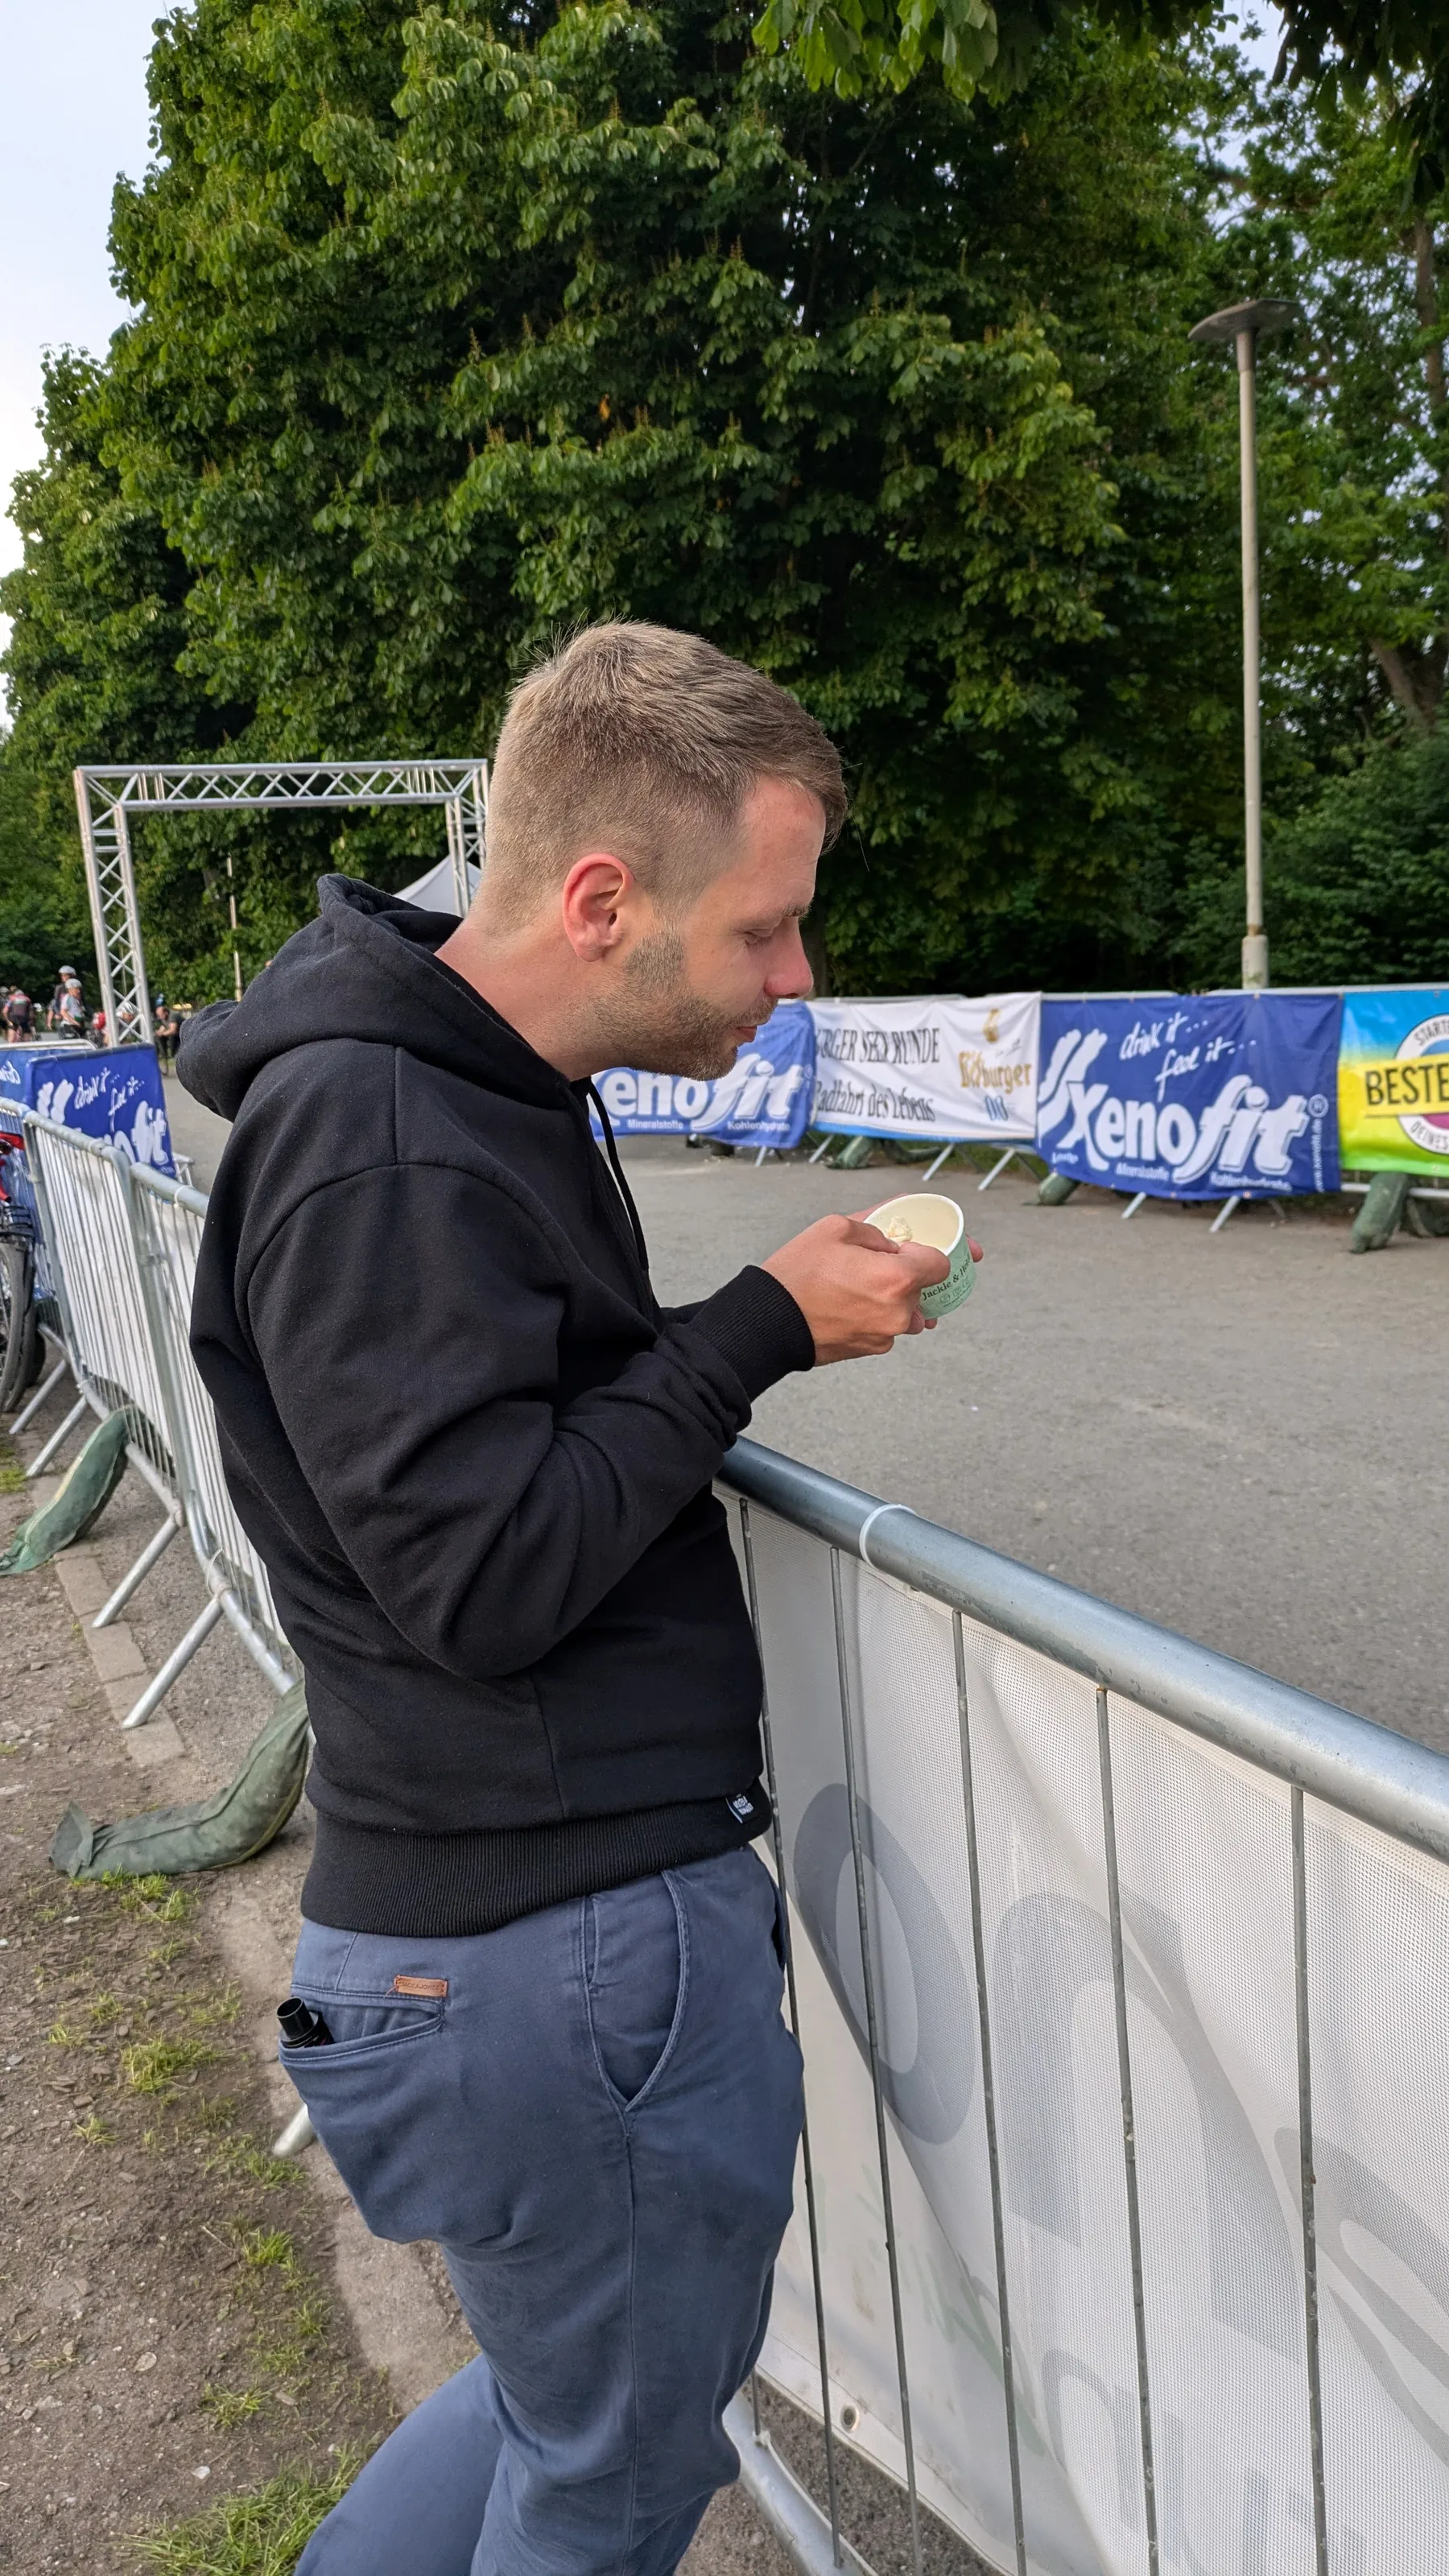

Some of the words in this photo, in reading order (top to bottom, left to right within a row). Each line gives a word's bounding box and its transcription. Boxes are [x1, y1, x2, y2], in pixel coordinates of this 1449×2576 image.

[890, 1027, 940, 1064] RUNDE
[1365, 1062, 1449, 1106] BESTE
[627, 1118, 683, 1129] Mineralstoffe
[727, 1120, 791, 1132] Kohlenhydrate
[952, 1274, 960, 1283] &
